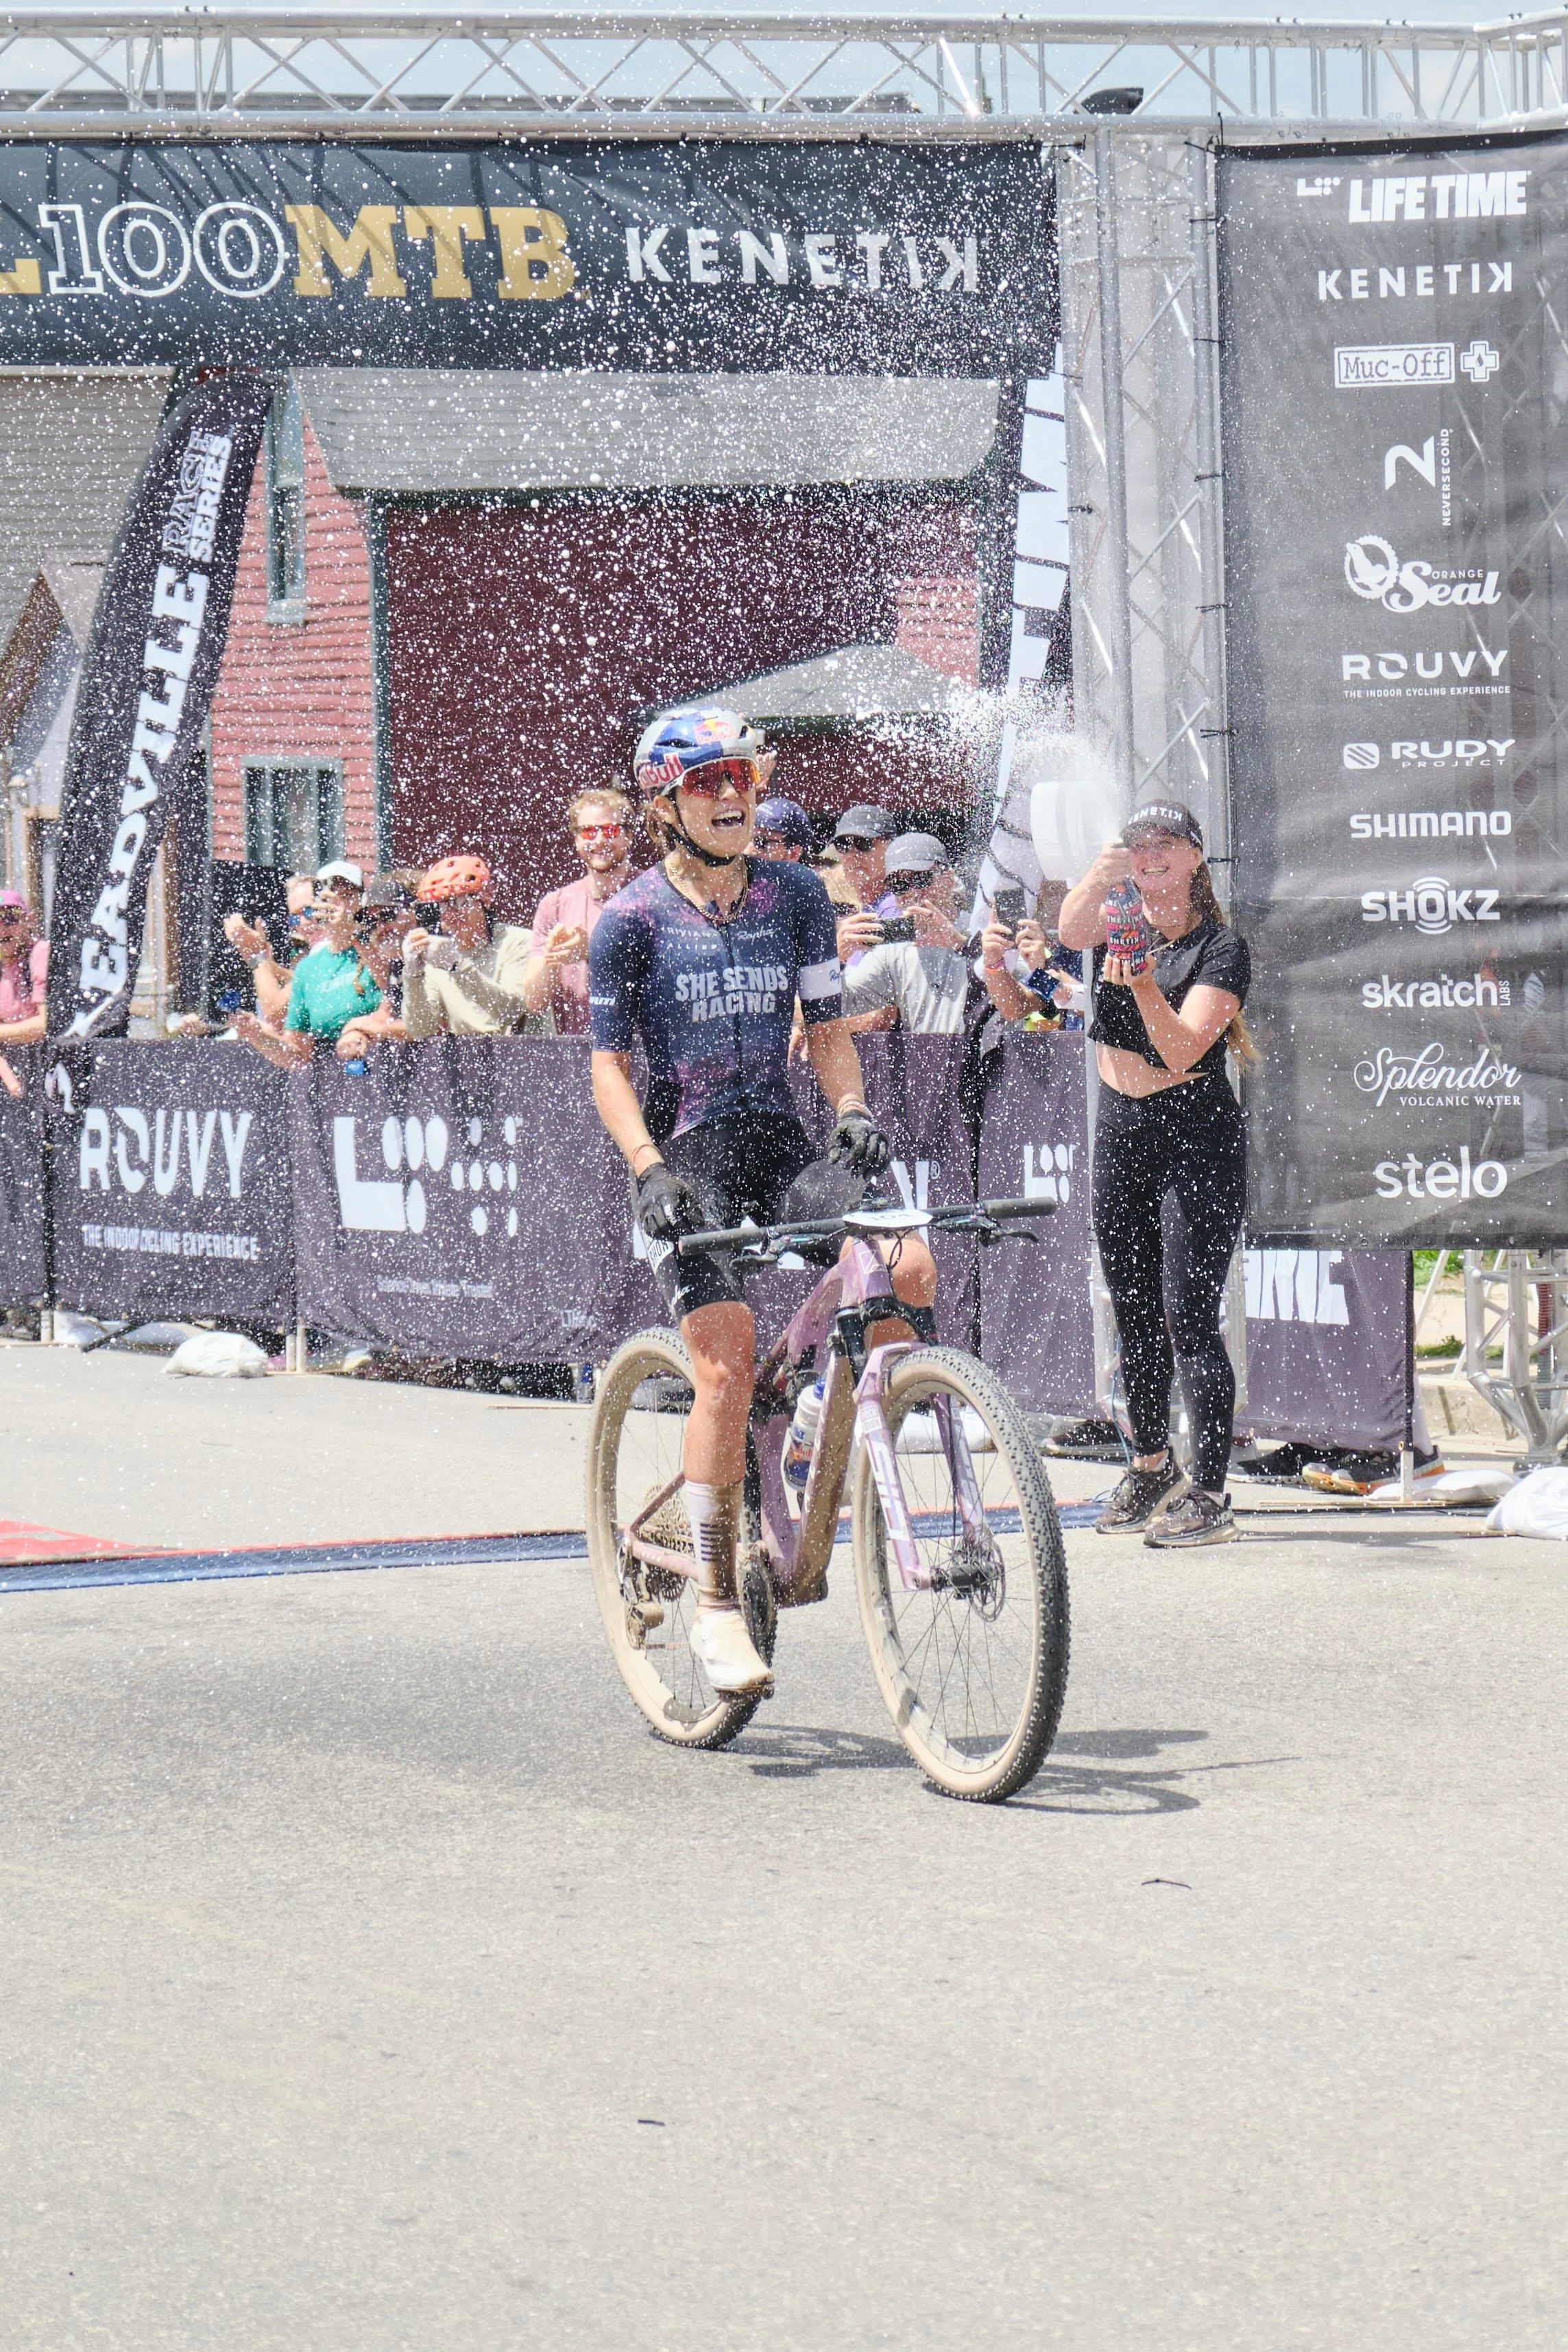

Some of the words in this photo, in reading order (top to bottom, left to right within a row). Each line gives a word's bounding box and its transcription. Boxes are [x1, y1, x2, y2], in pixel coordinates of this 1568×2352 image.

[625, 226, 978, 292] KENETIK
[1317, 261, 1512, 301] KENETIK
[1343, 351, 1447, 379] Muc-Off
[161, 430, 215, 555] RACE
[1440, 428, 1452, 527] NEVERSECOND
[189, 435, 234, 563] SERIES
[1382, 560, 1501, 613] Seal
[1432, 569, 1484, 579] ORANGE
[1342, 649, 1508, 681] ROUVY
[1344, 690, 1362, 699] THE
[1366, 688, 1402, 697] INDOOR
[1406, 687, 1447, 697] CYCLING
[1450, 686, 1511, 695] EXPERIENCE
[1391, 739, 1517, 760] RUDY
[1401, 758, 1506, 769] PROJECT
[1350, 811, 1512, 839] SHIMANO
[1361, 889, 1501, 922] SHOKZ
[675, 971, 721, 1002] SHE
[723, 965, 788, 992] SENDS
[1362, 974, 1498, 1008] skratch
[1499, 980, 1511, 1006] LABS
[692, 992, 776, 1023] RACING
[1353, 1042, 1522, 1107] Splendor
[1400, 1095, 1469, 1107] VOLCANIC
[1474, 1094, 1522, 1106] WATER
[80, 1107, 252, 1199] ROUVY
[1375, 1144, 1508, 1199] stelo
